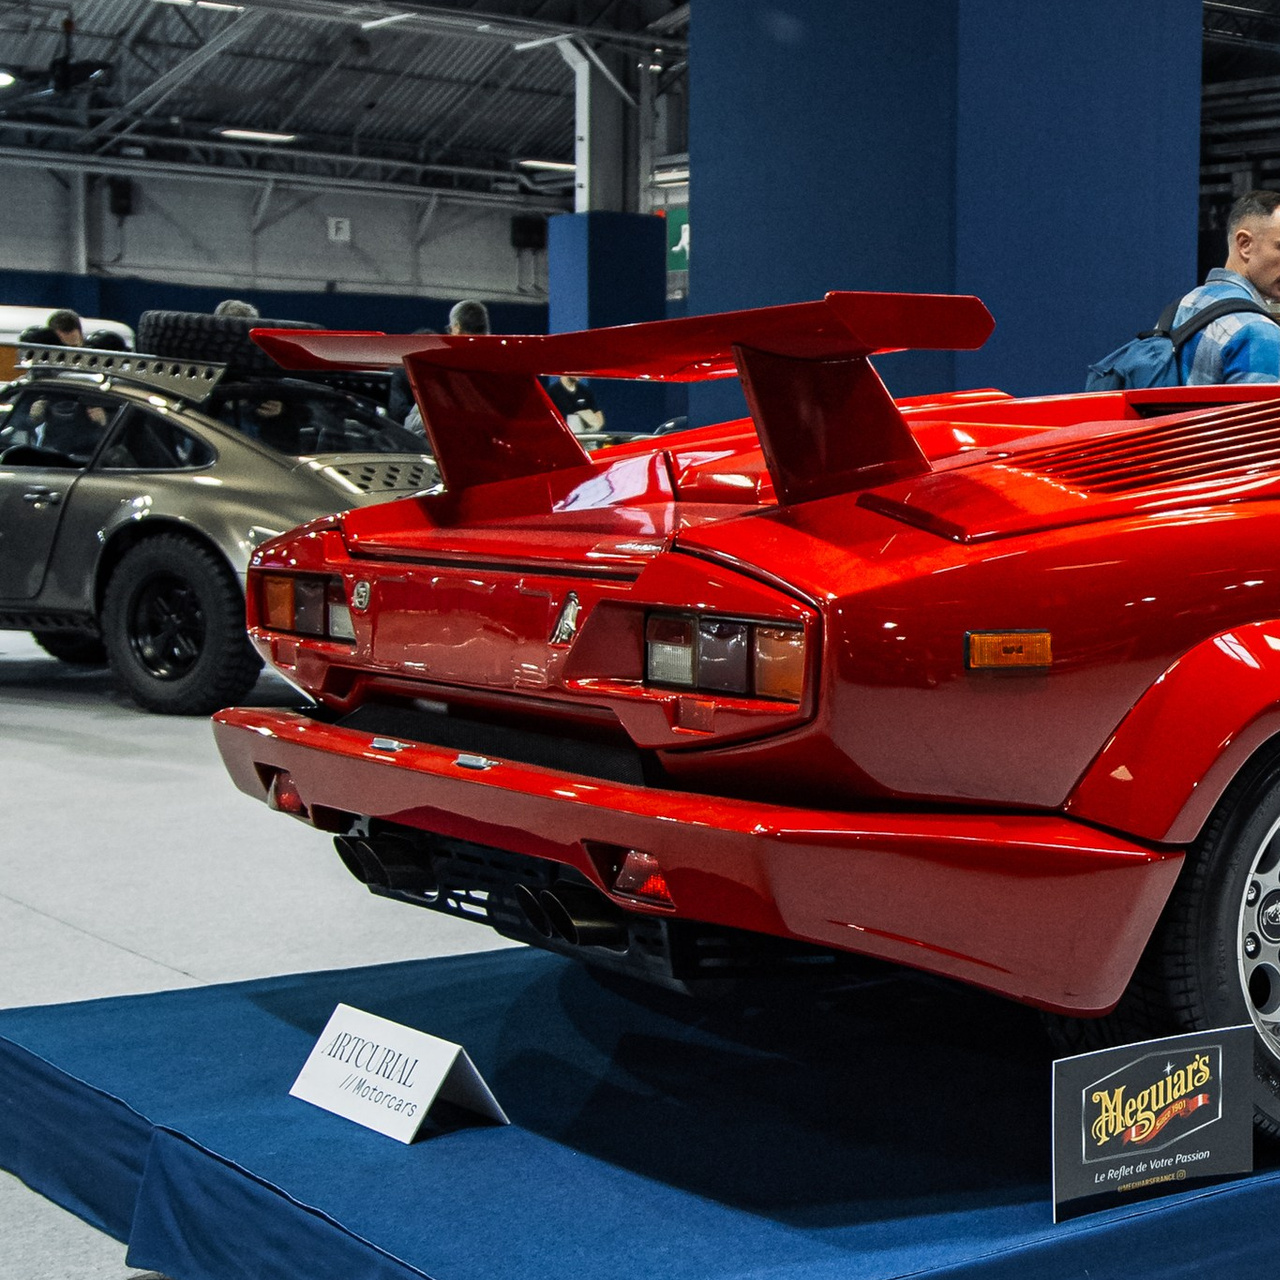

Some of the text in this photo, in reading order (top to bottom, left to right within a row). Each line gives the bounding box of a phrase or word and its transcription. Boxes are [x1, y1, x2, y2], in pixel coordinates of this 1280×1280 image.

[334, 220, 344, 237] F
[321, 1031, 419, 1088] ARTCURIAL
[1092, 1054, 1210, 1146] Meguiar's
[1171, 1100, 1186, 1113] 1901
[1094, 1149, 1210, 1184] Le Reflet de Votre Passion
